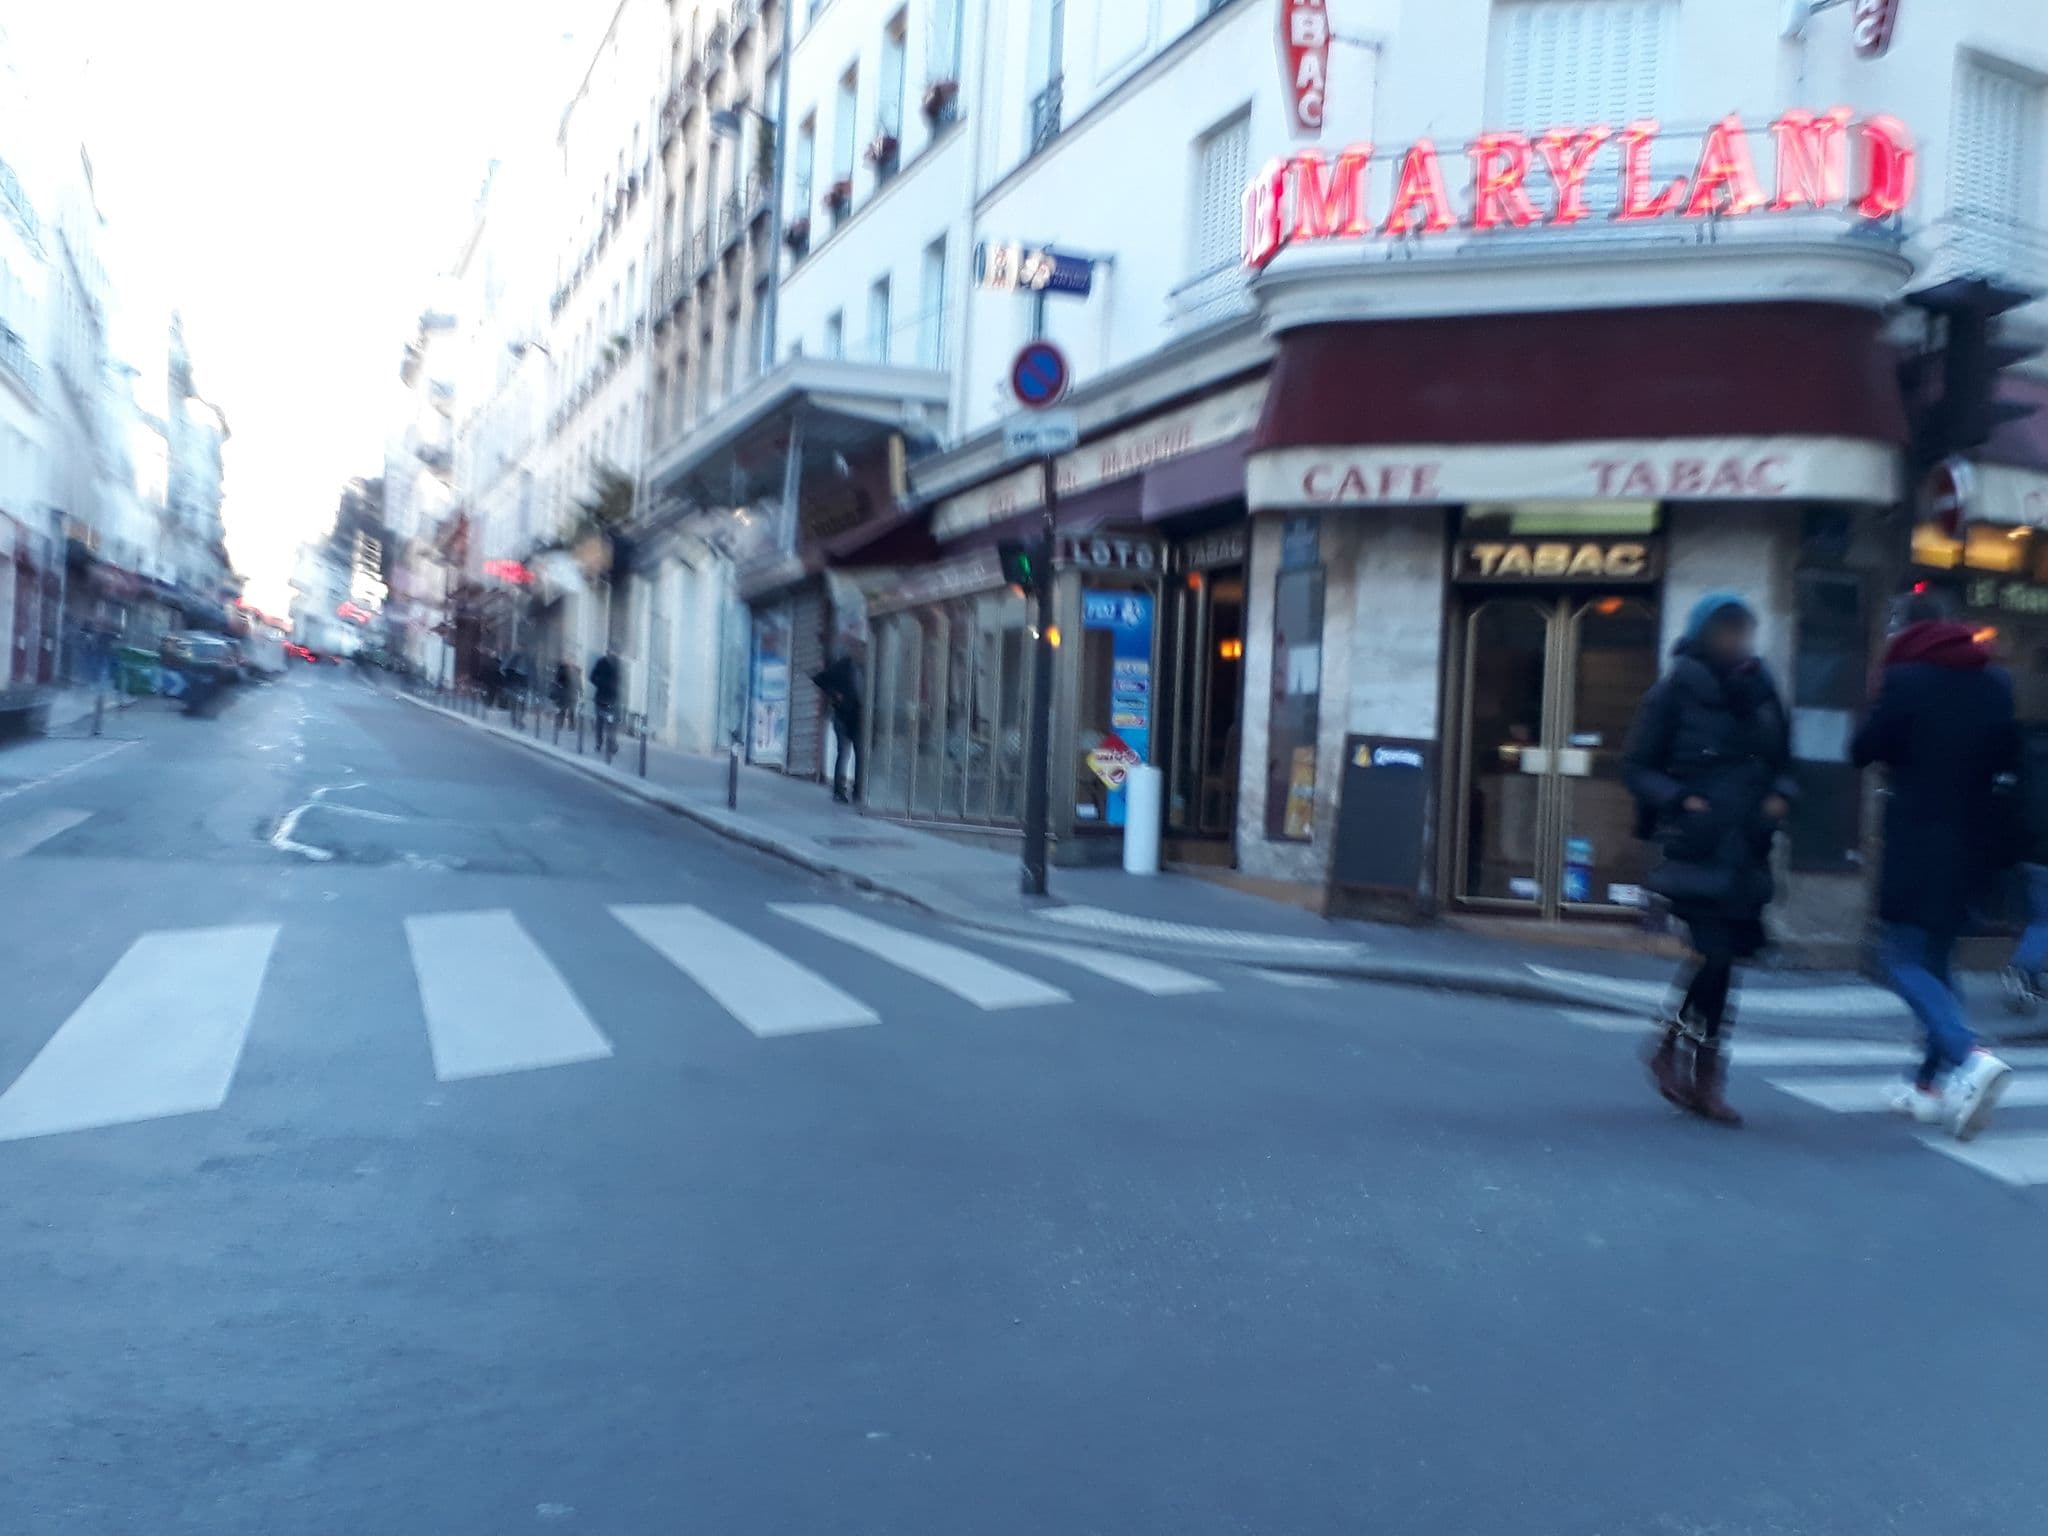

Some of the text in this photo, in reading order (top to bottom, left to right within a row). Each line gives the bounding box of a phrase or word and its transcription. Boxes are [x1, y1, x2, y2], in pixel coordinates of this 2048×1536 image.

[1292, 104, 1919, 243] MARYLAND
[1303, 455, 1790, 501] CAFE TABAC
[1072, 540, 1156, 570] LOTO
[1471, 542, 1647, 577] TABAC
